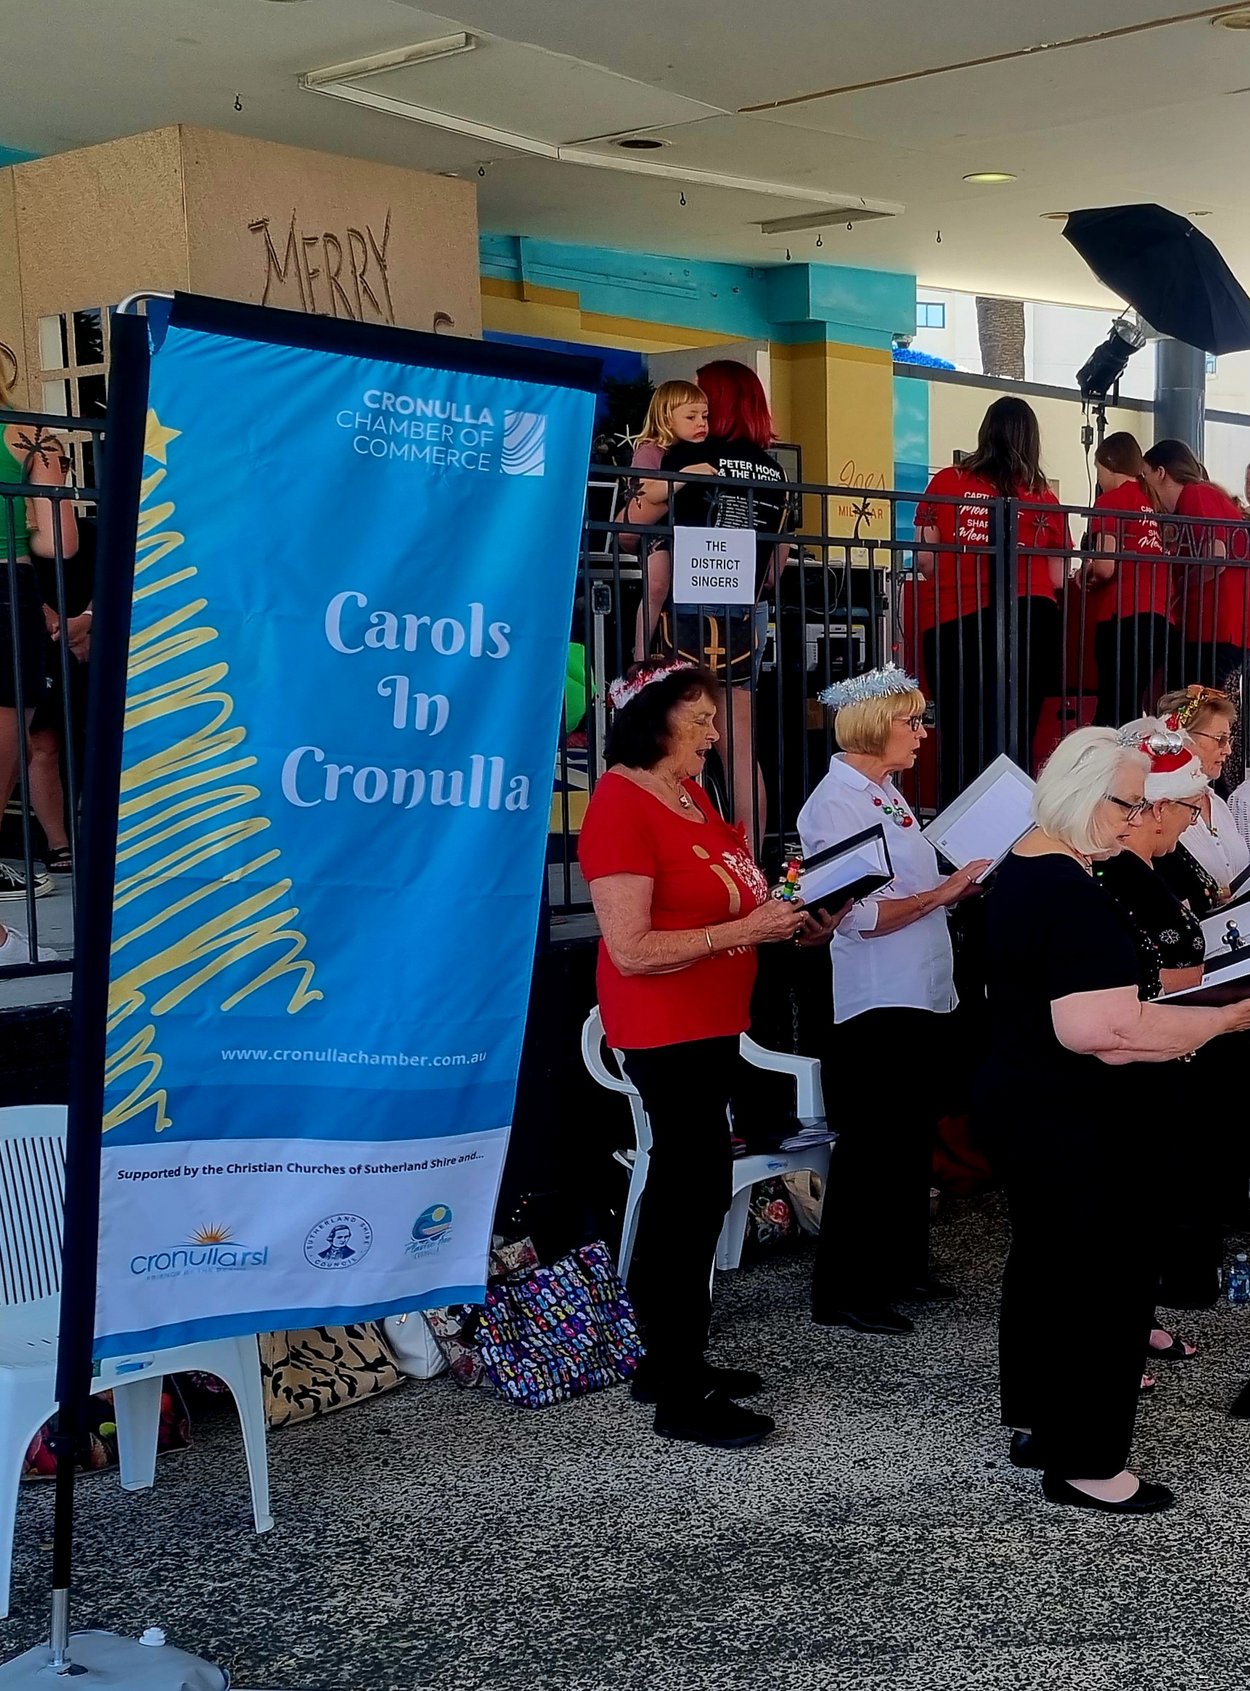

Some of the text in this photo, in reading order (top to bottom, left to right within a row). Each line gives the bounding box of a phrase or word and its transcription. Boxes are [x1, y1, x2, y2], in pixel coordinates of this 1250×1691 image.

[247, 203, 396, 325] MERRY
[363, 389, 496, 427] CRONULLA
[336, 410, 495, 448] CHAMBER OF
[353, 435, 493, 472] COMMERCE
[718, 468, 726, 478] &
[730, 469, 750, 480] THE
[719, 458, 782, 481] PETER HOOK
[838, 505, 858, 518] MIL
[706, 540, 728, 553] THE
[691, 557, 741, 571] DISTRICT
[691, 575, 739, 589] SINGERS
[324, 590, 512, 660] Carols
[376, 674, 451, 737] In
[280, 745, 531, 812] Cronulla
[220, 1047, 487, 1068] www.cronullachamber.com.au
[117, 1151, 485, 1182] Supported by the Christian Churches of Sutherland Shire and...
[306, 1216, 370, 1250] SUTHERLAND SHIRE
[314, 1258, 358, 1268] COUNCIL
